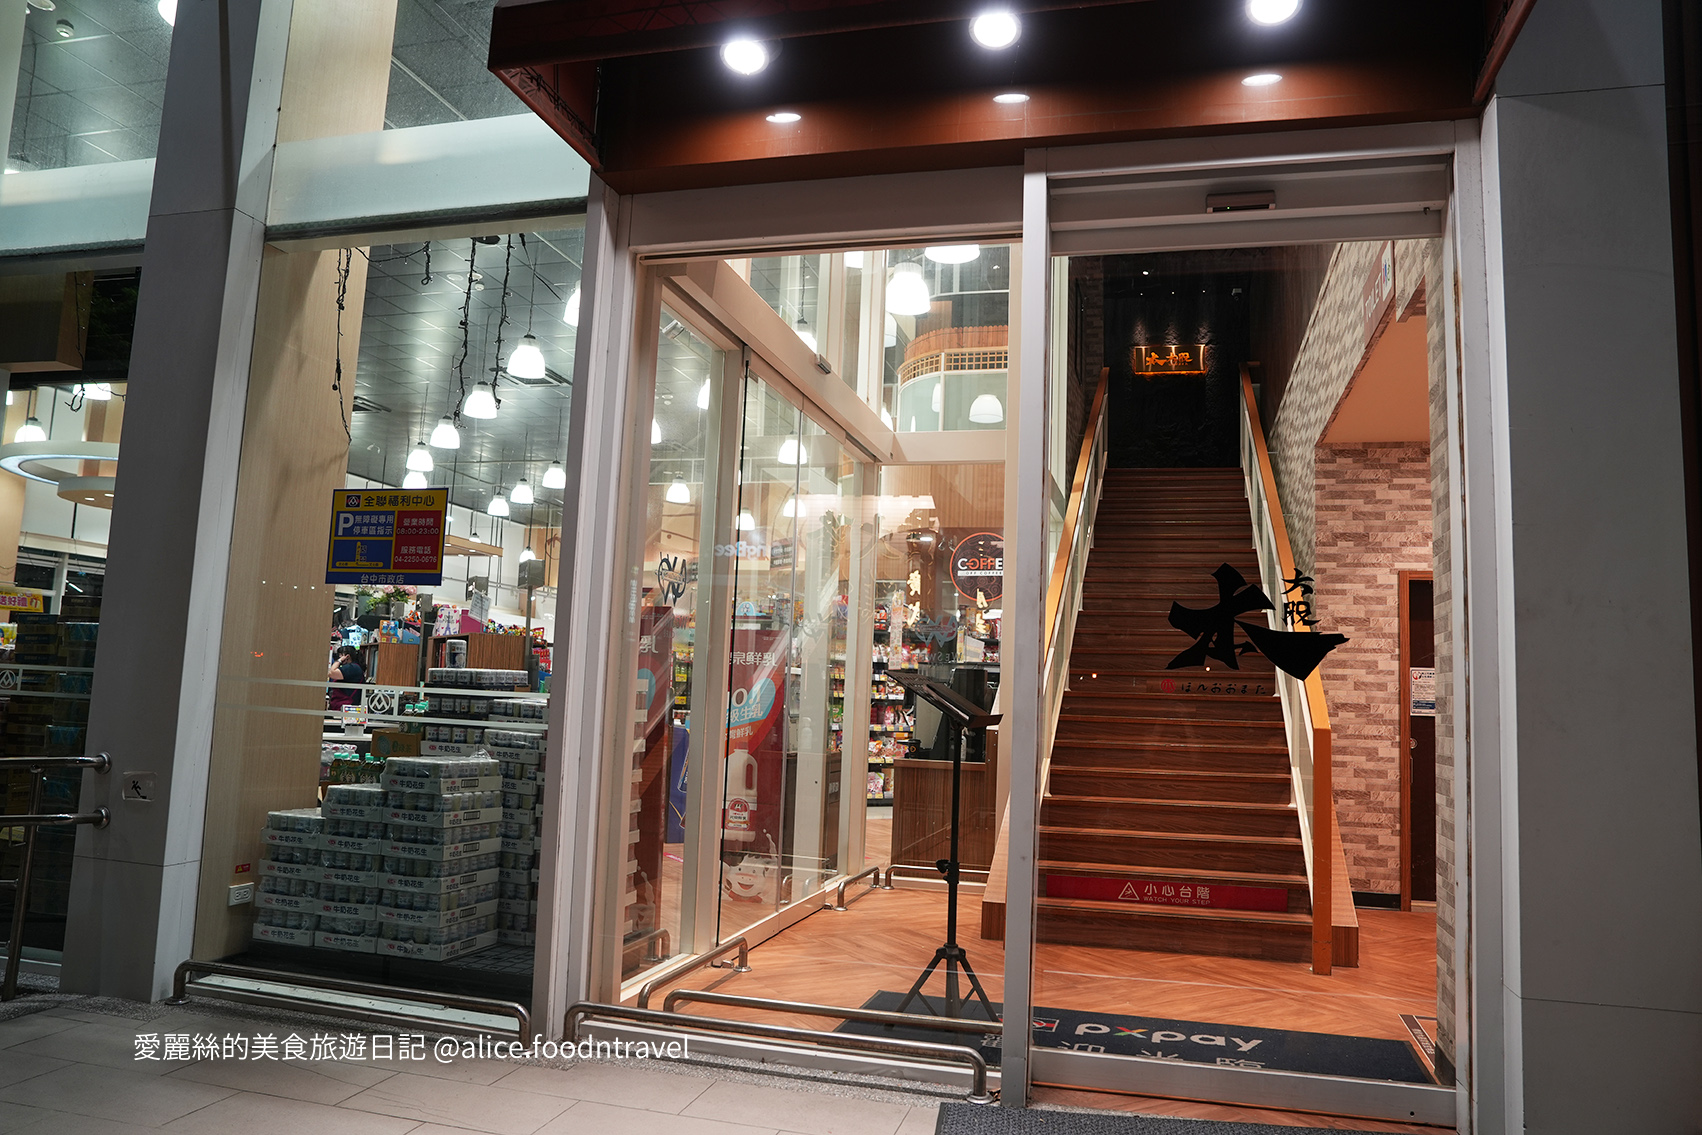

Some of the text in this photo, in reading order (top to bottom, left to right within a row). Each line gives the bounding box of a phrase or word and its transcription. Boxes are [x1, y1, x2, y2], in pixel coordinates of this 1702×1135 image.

[363, 494, 435, 507] 全聯福利中心
[337, 512, 354, 536] P
[354, 515, 394, 524] 無障礙專用
[403, 517, 434, 526] 營業時間
[352, 525, 393, 535] 停車區指示
[400, 545, 431, 554] 服務電話
[360, 573, 405, 584] 台中市政店
[1181, 682, 1267, 695] ほんおおまた
[438, 745, 461, 754] 牛奶花生
[496, 750, 521, 760] 牛奶花生
[399, 780, 425, 790] 牛奶花生
[401, 812, 428, 823] 牛奶花生
[337, 840, 363, 850] 牛奶花生
[401, 845, 428, 856] 牛奶花生
[397, 879, 424, 889] 牛奶花生
[1144, 883, 1211, 900] 小心台階
[1143, 895, 1168, 903] WATCH
[333, 905, 359, 915] 牛奶花生
[1074, 1022, 1264, 1053] pxpay
